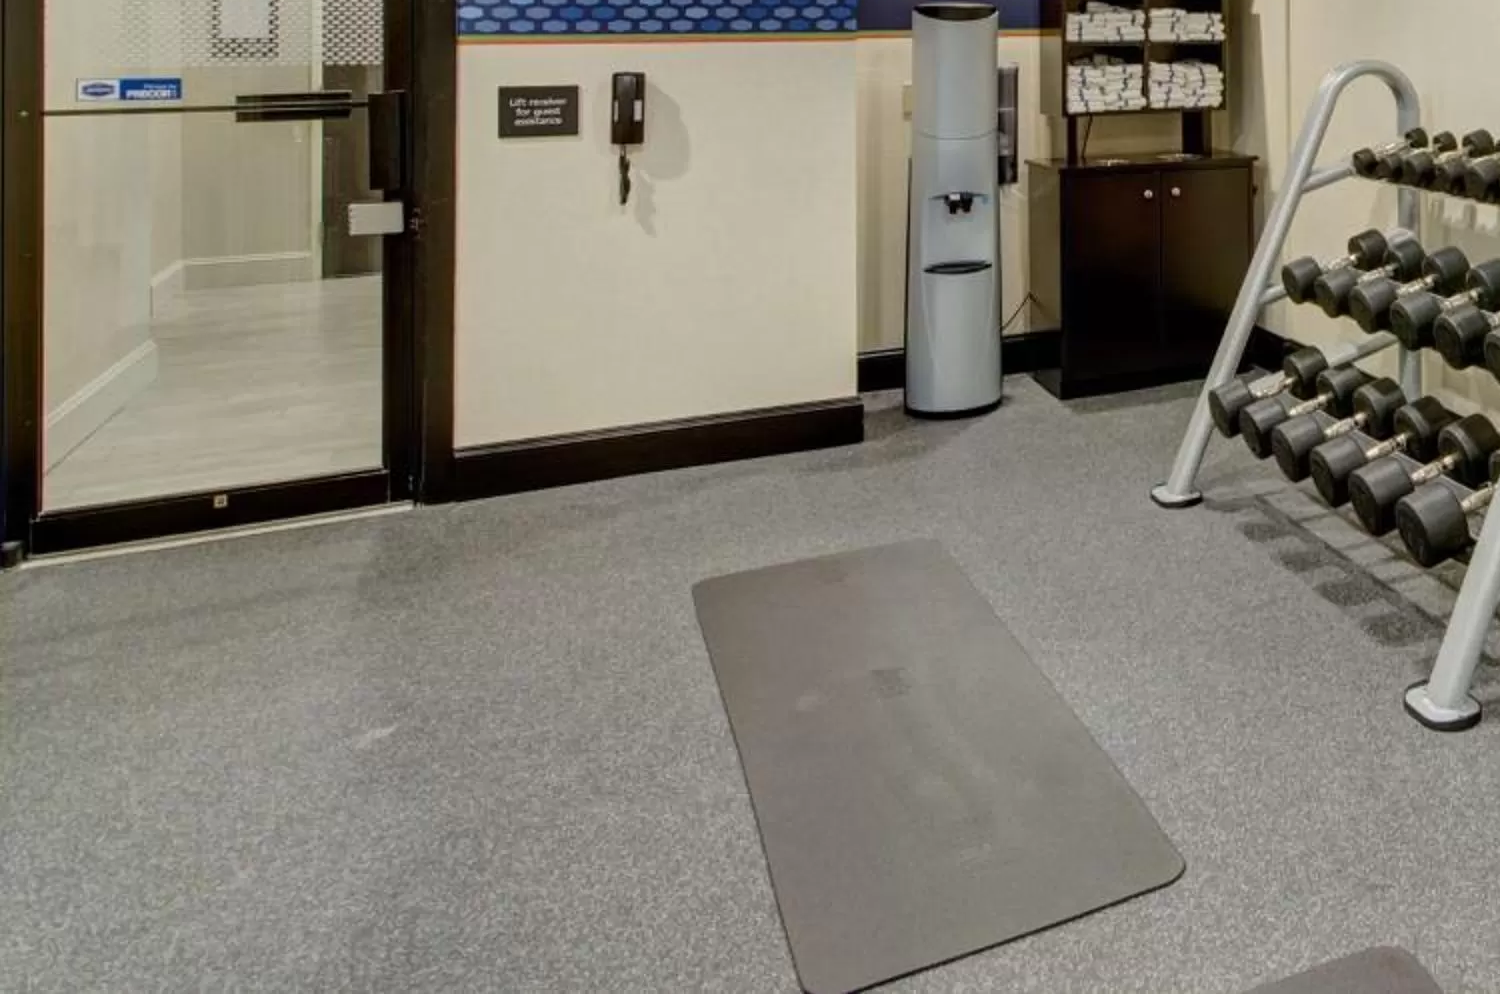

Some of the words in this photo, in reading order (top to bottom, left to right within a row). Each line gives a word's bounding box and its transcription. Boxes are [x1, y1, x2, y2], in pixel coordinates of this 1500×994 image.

[509, 97, 527, 107] Lift
[515, 107, 530, 116] for
[533, 107, 561, 117] guest
